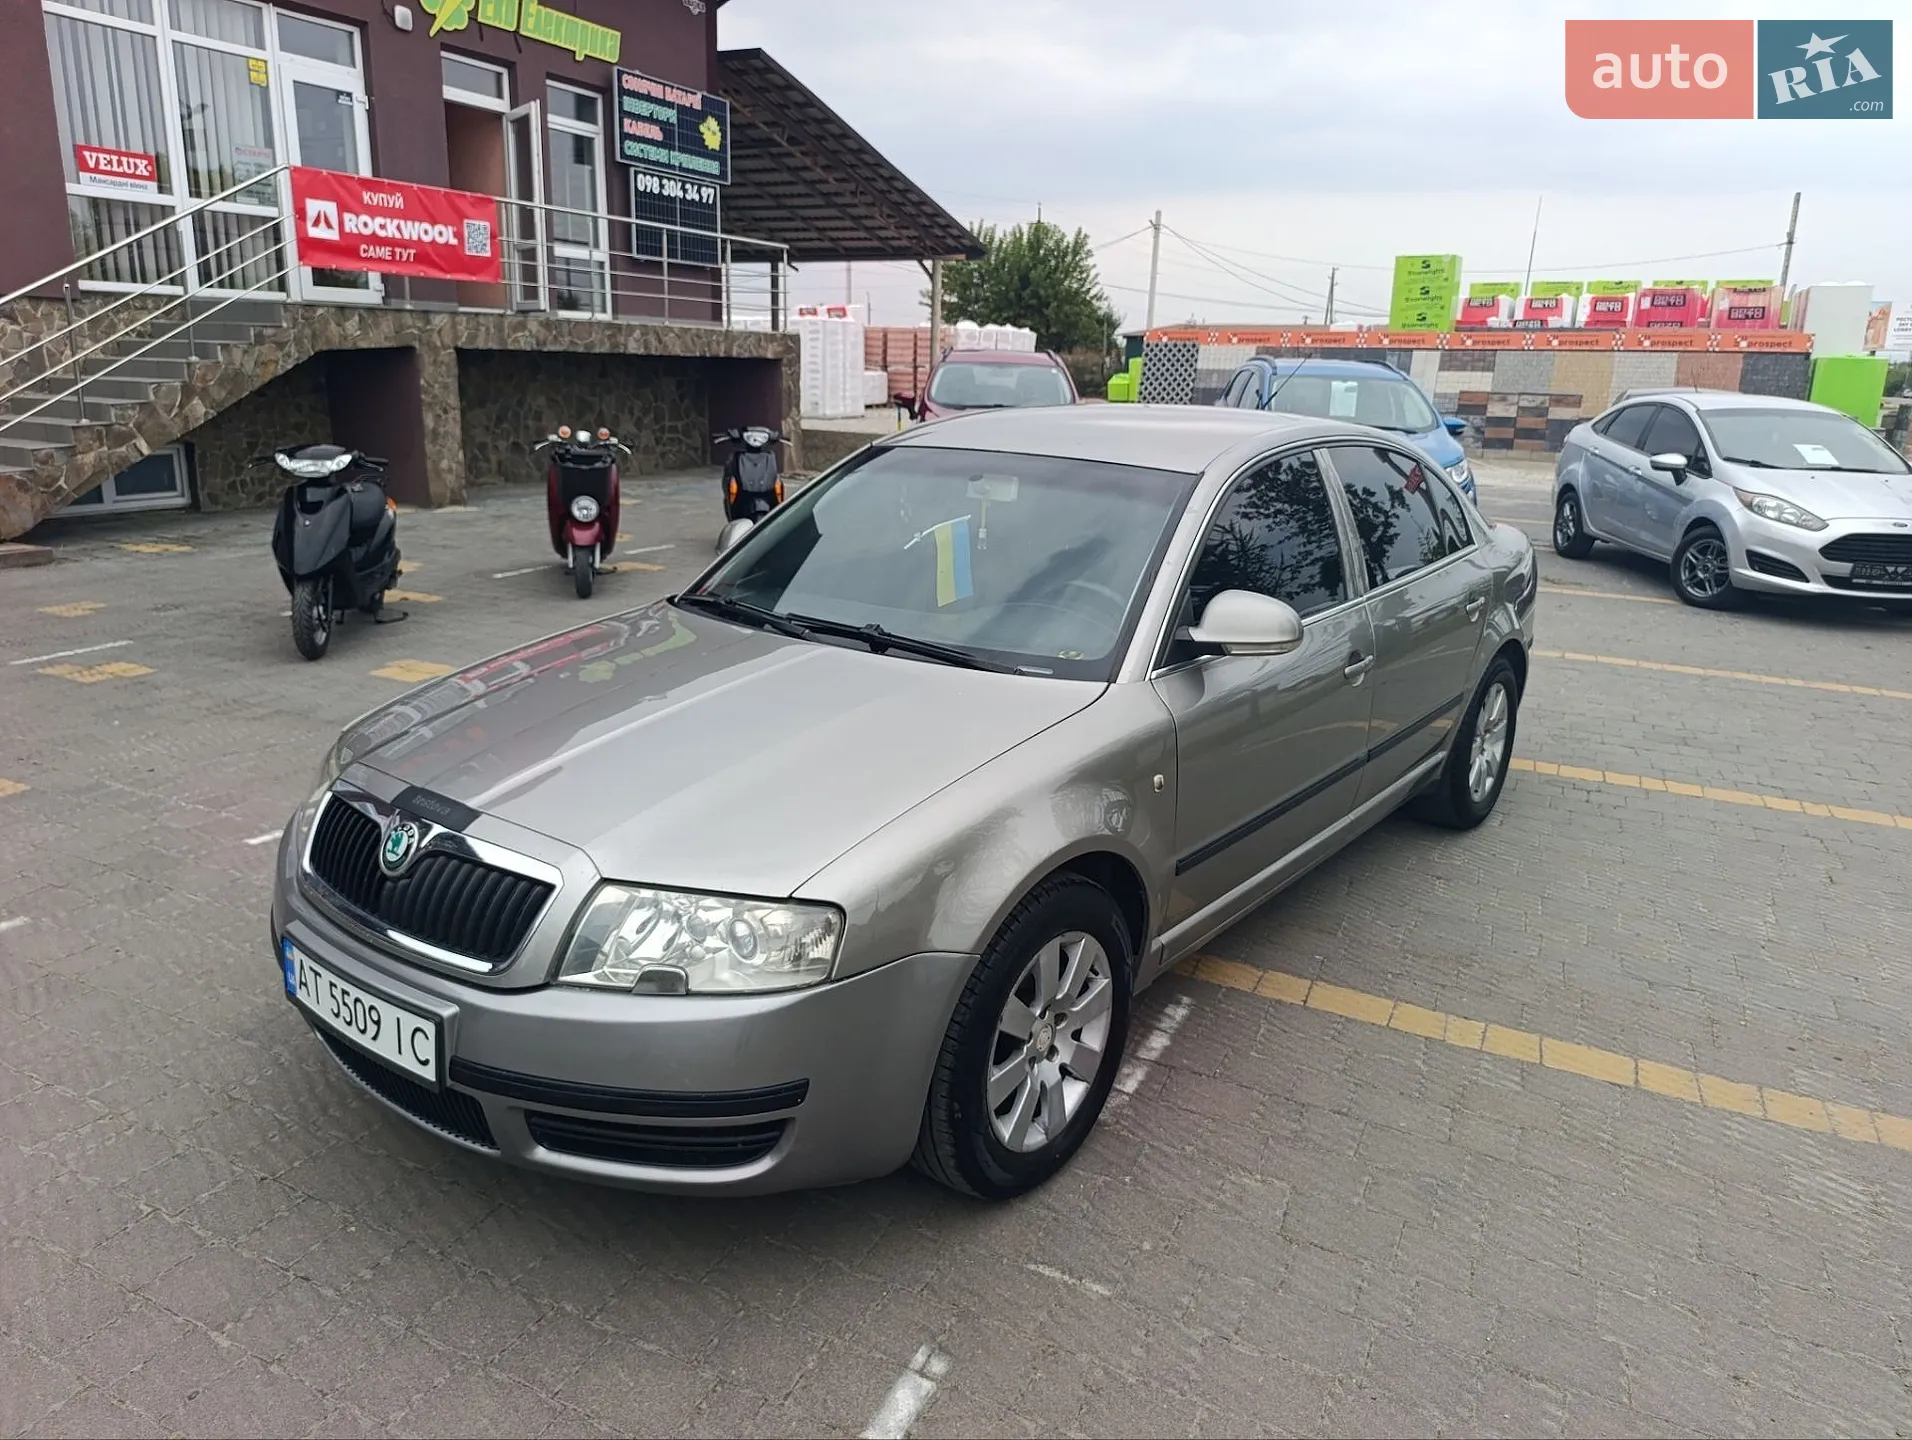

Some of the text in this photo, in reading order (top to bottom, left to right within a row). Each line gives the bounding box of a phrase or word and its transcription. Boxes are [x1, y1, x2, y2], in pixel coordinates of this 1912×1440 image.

[82, 151, 150, 176] VELUX
[636, 173, 715, 204] 098 304 34 97
[362, 191, 405, 210] КУПУЙ
[343, 212, 458, 245] ROCKWOOL
[359, 243, 416, 262] САМЕ ТУТ
[1472, 338, 1510, 346] prospect
[1557, 338, 1599, 346] prospect
[1649, 339, 1693, 347] prospect
[1747, 340, 1792, 348] prospect
[299, 959, 430, 1066] AT 5509 IC
